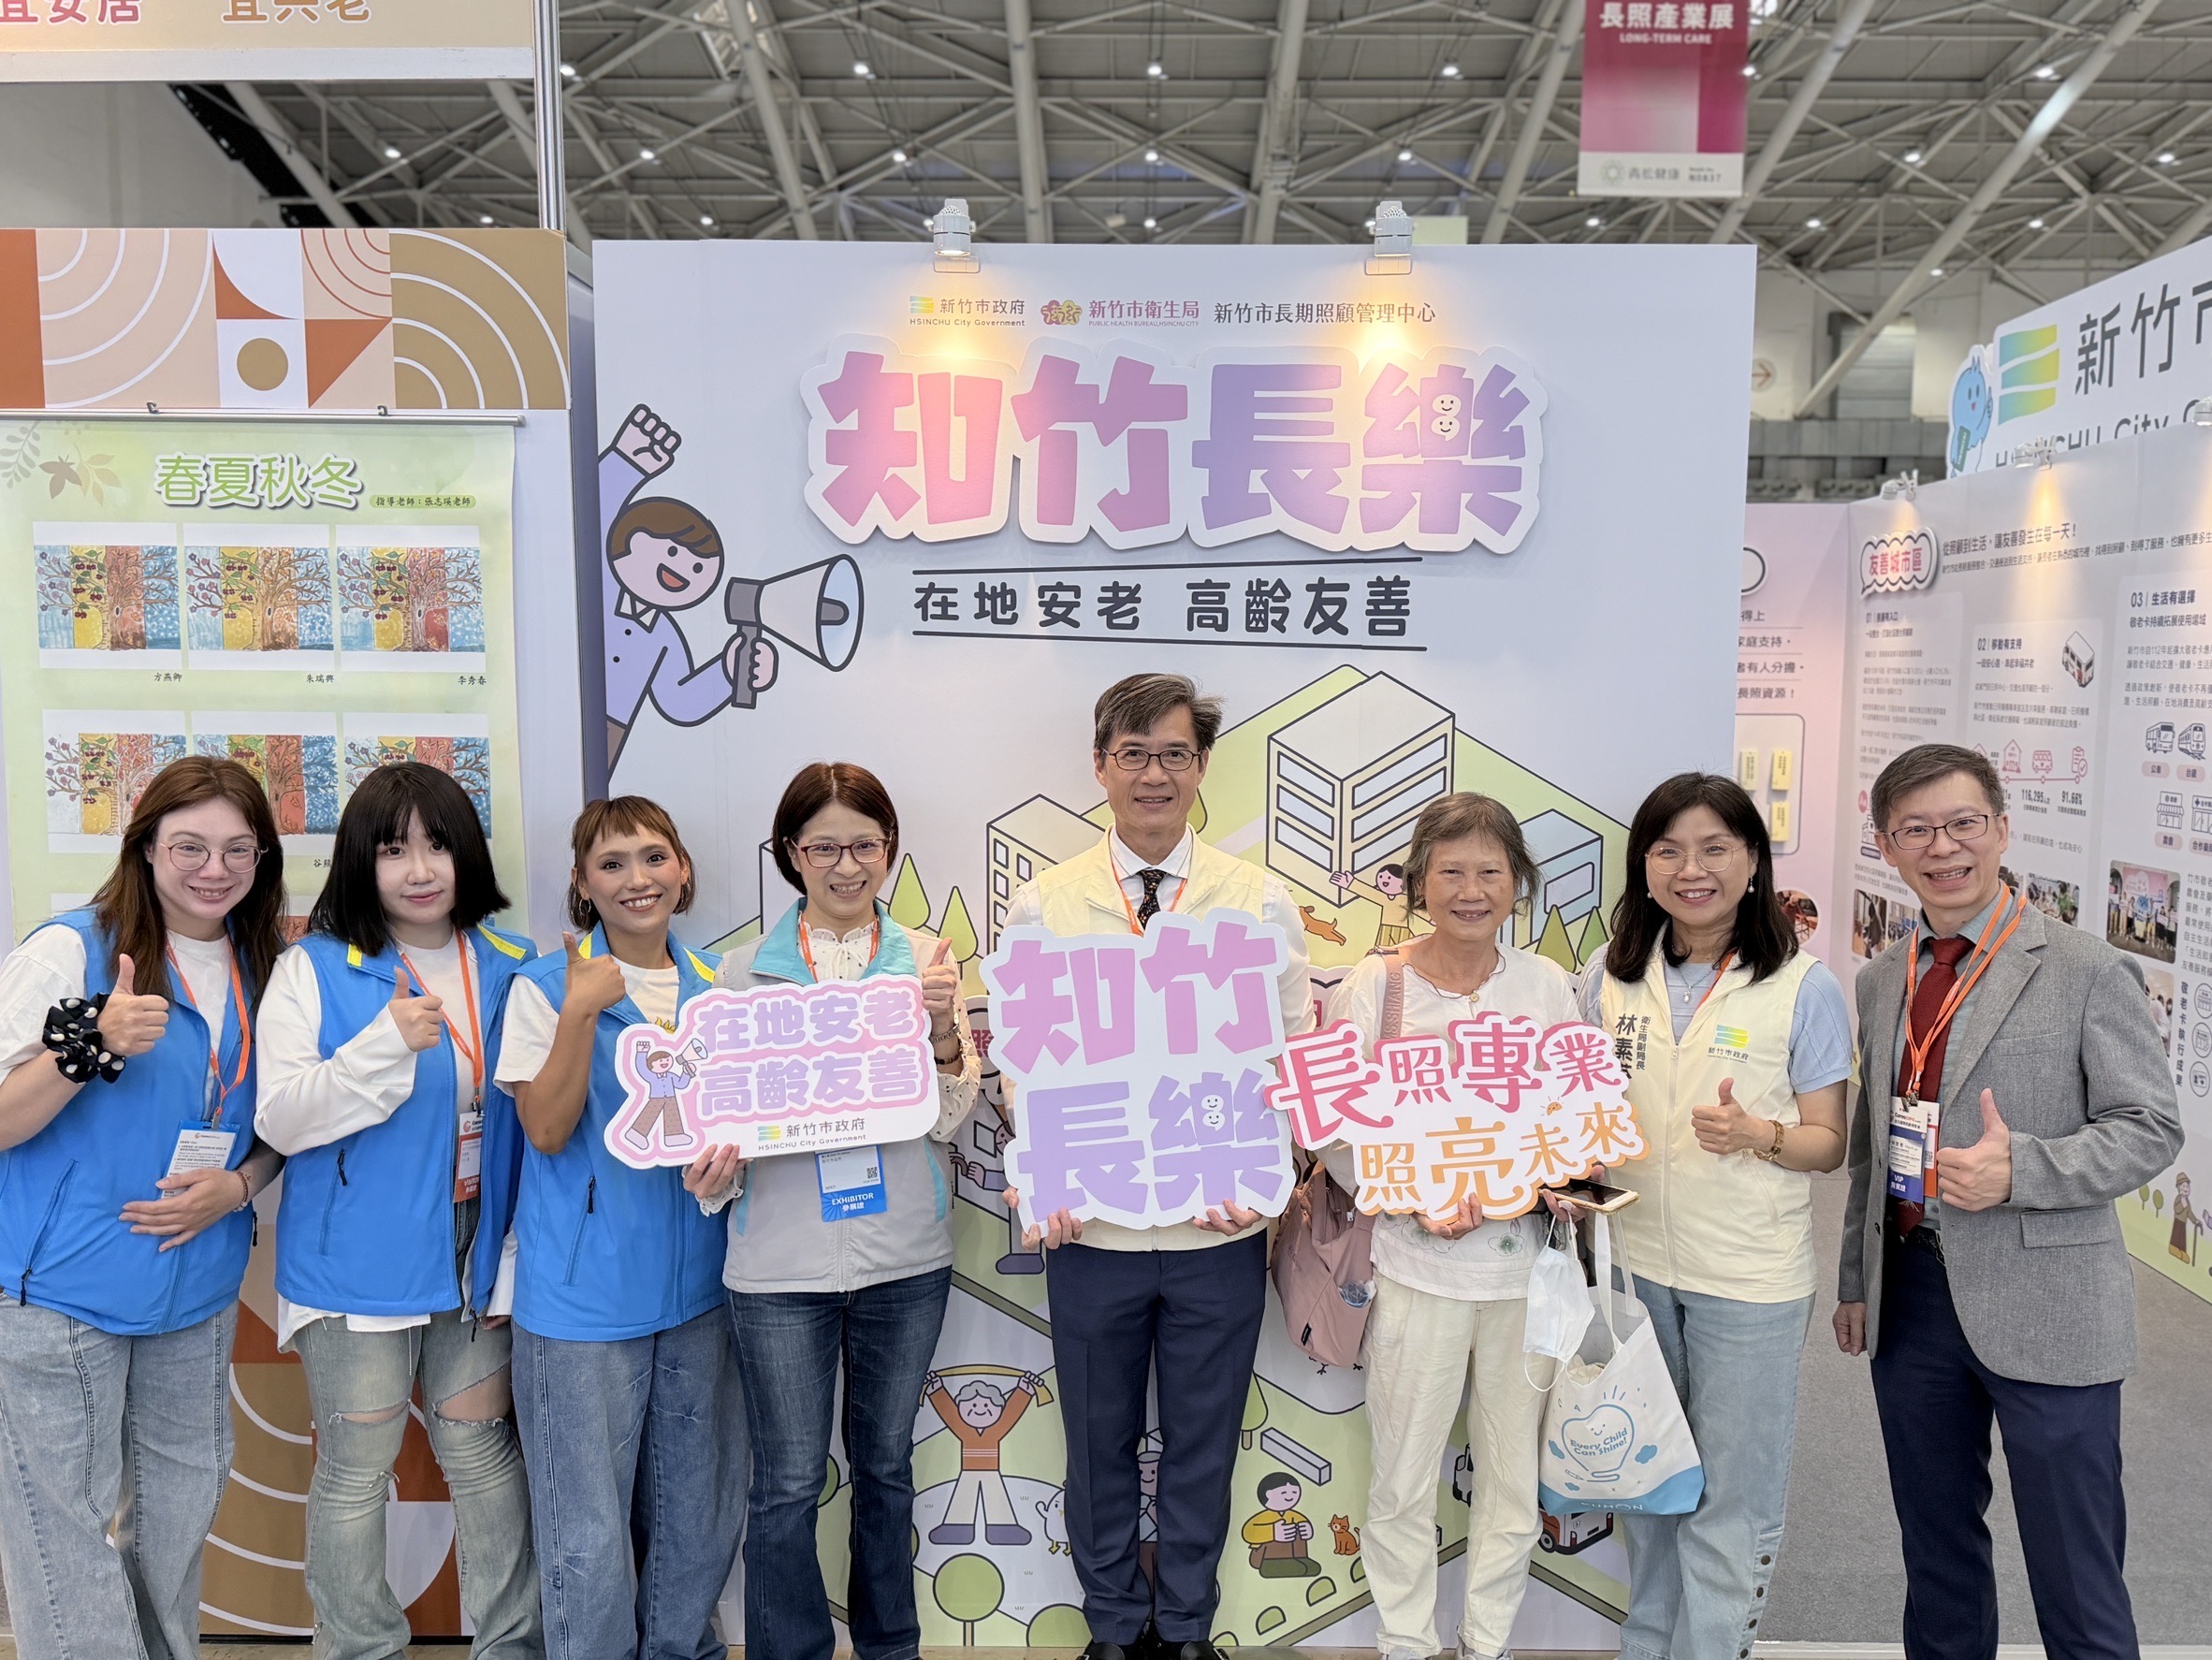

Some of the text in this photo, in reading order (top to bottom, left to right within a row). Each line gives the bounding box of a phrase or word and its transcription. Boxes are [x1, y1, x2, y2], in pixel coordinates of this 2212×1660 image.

[1600, 3, 1734, 29] 長照產業展
[1620, 33, 1712, 45] LONG-TERM CARE
[940, 299, 1025, 314] 新竹市政府
[1089, 299, 1200, 319] 新竹市衛生局
[1214, 302, 1436, 324] 新竹市長期照顧管理中心
[953, 318, 971, 328] City
[974, 318, 1026, 327] Government
[817, 351, 1531, 537] 知竹長樂
[155, 454, 361, 507] 春夏秋冬
[914, 574, 1411, 637] 在地安老 高齡友善
[2131, 592, 2143, 607] 03
[2151, 590, 2195, 605] 生活有選擇
[1977, 638, 1986, 650] 02
[992, 921, 1277, 1074] 知竹
[698, 989, 915, 1053] 在地安老
[1636, 1015, 1651, 1070] 衛生局副局長
[1708, 1046, 1749, 1060] 新竹市政府
[701, 1048, 919, 1115] 高齡友善
[1279, 1023, 1622, 1143] 長照專業
[786, 1117, 866, 1138] 新竹市政府
[758, 1133, 866, 1151] HSINCHU City Government
[1017, 1069, 1283, 1223] 長樂
[1361, 1101, 1635, 1212] 照亮未來
[1894, 1174, 1904, 1184] VIP
[831, 1192, 874, 1206] EXHIBITOR
[1570, 1427, 1627, 1450] Every Child
[1574, 1436, 1627, 1456] Can Shine!
